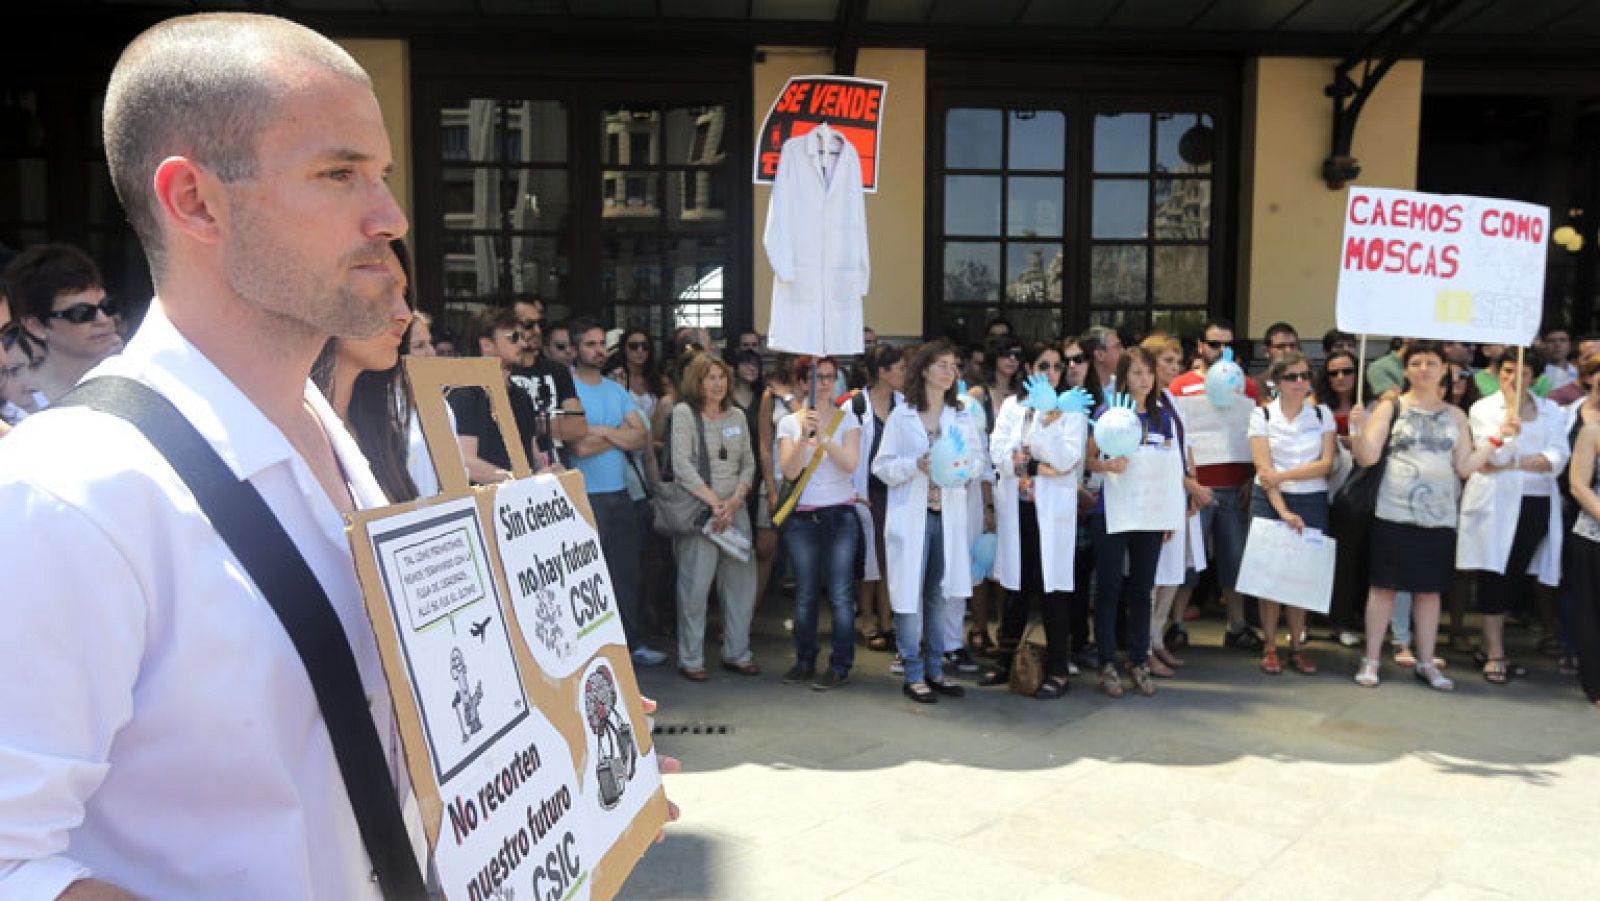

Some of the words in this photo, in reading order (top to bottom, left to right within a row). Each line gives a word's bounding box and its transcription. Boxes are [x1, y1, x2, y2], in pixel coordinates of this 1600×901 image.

[776, 83, 810, 113] SE
[809, 83, 880, 122] VENDE
[1349, 195, 1464, 234] CAEMOS
[1480, 209, 1543, 244] COMO
[1343, 236, 1460, 279] MOSCAS
[499, 504, 527, 540] Sin
[525, 489, 576, 533] ciencia,
[517, 566, 538, 598] no
[533, 553, 565, 588] hay
[562, 540, 599, 574] futuro
[570, 572, 609, 627] CSIC
[447, 794, 478, 846] No
[477, 742, 542, 821] recorten
[466, 826, 530, 901] nuestro
[526, 784, 572, 845] futuro
[533, 831, 580, 901] CSIC
